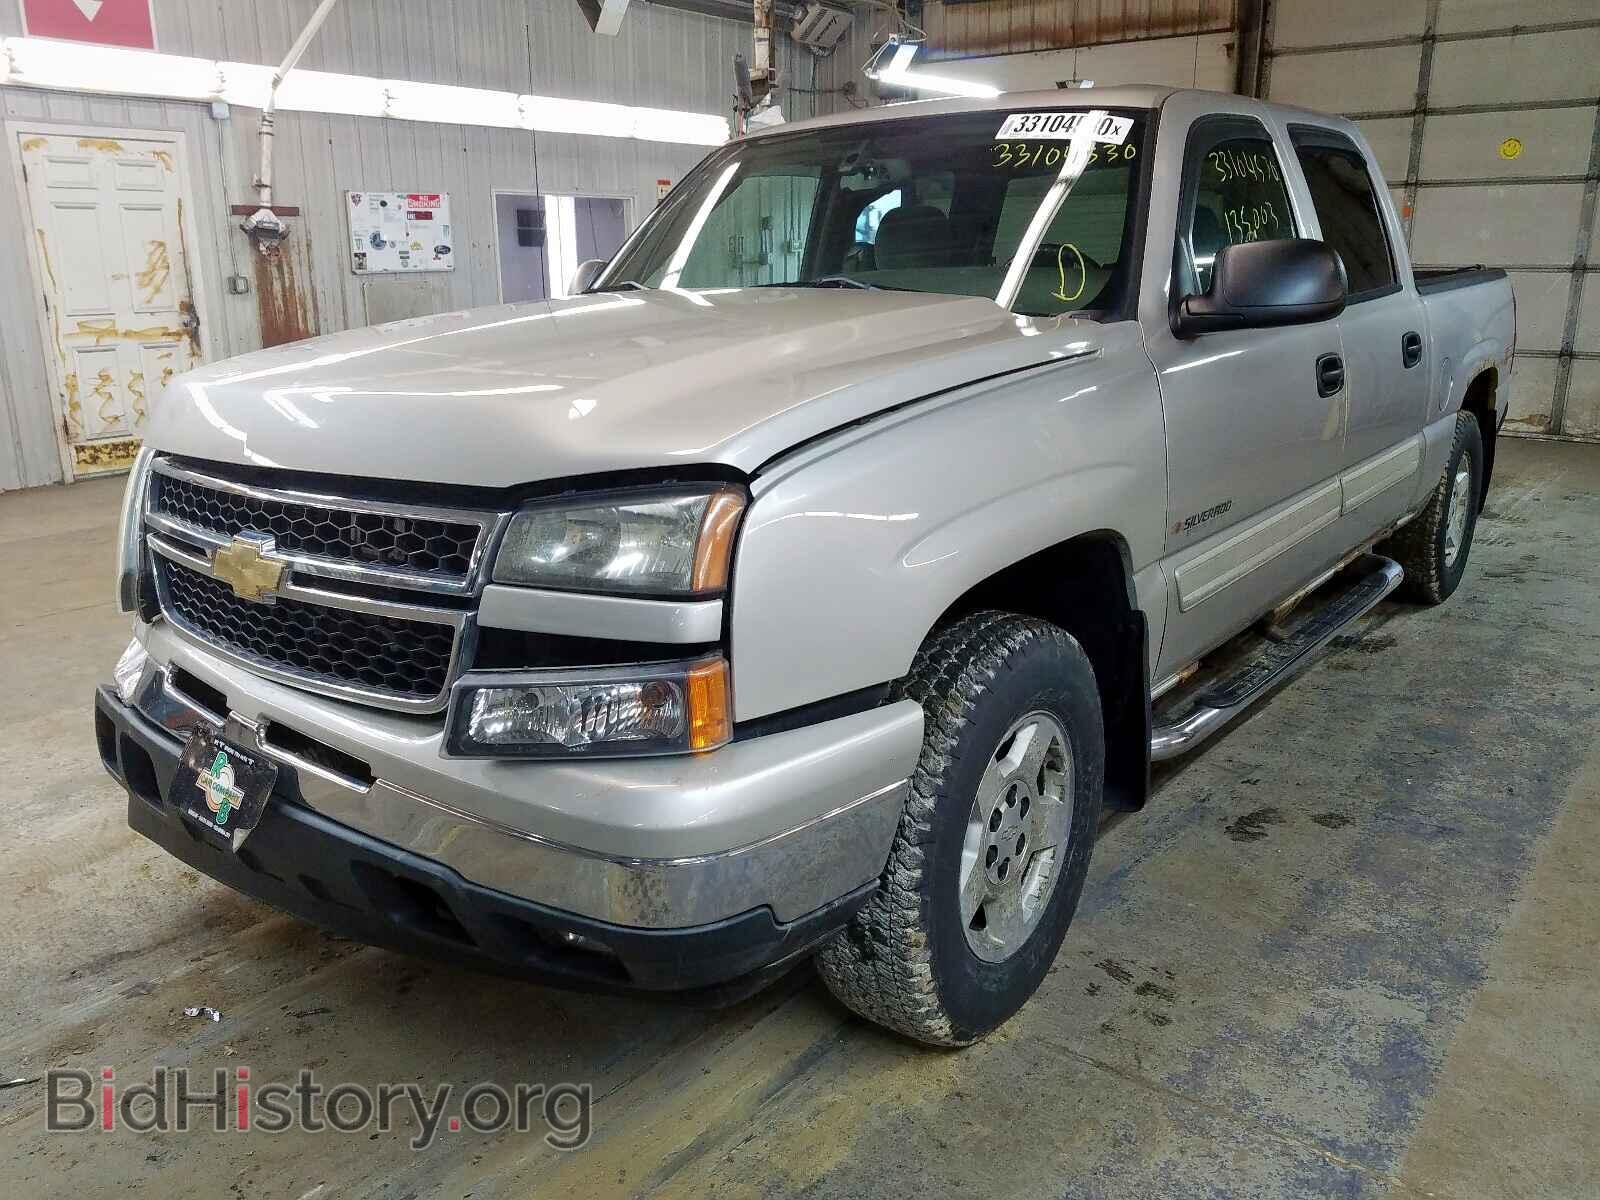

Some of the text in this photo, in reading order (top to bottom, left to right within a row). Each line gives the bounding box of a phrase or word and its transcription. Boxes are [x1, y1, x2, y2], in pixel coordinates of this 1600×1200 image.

[1013, 115, 1122, 136] 331040x
[1050, 243, 1086, 301] D
[1183, 500, 1233, 531] SILVERADO
